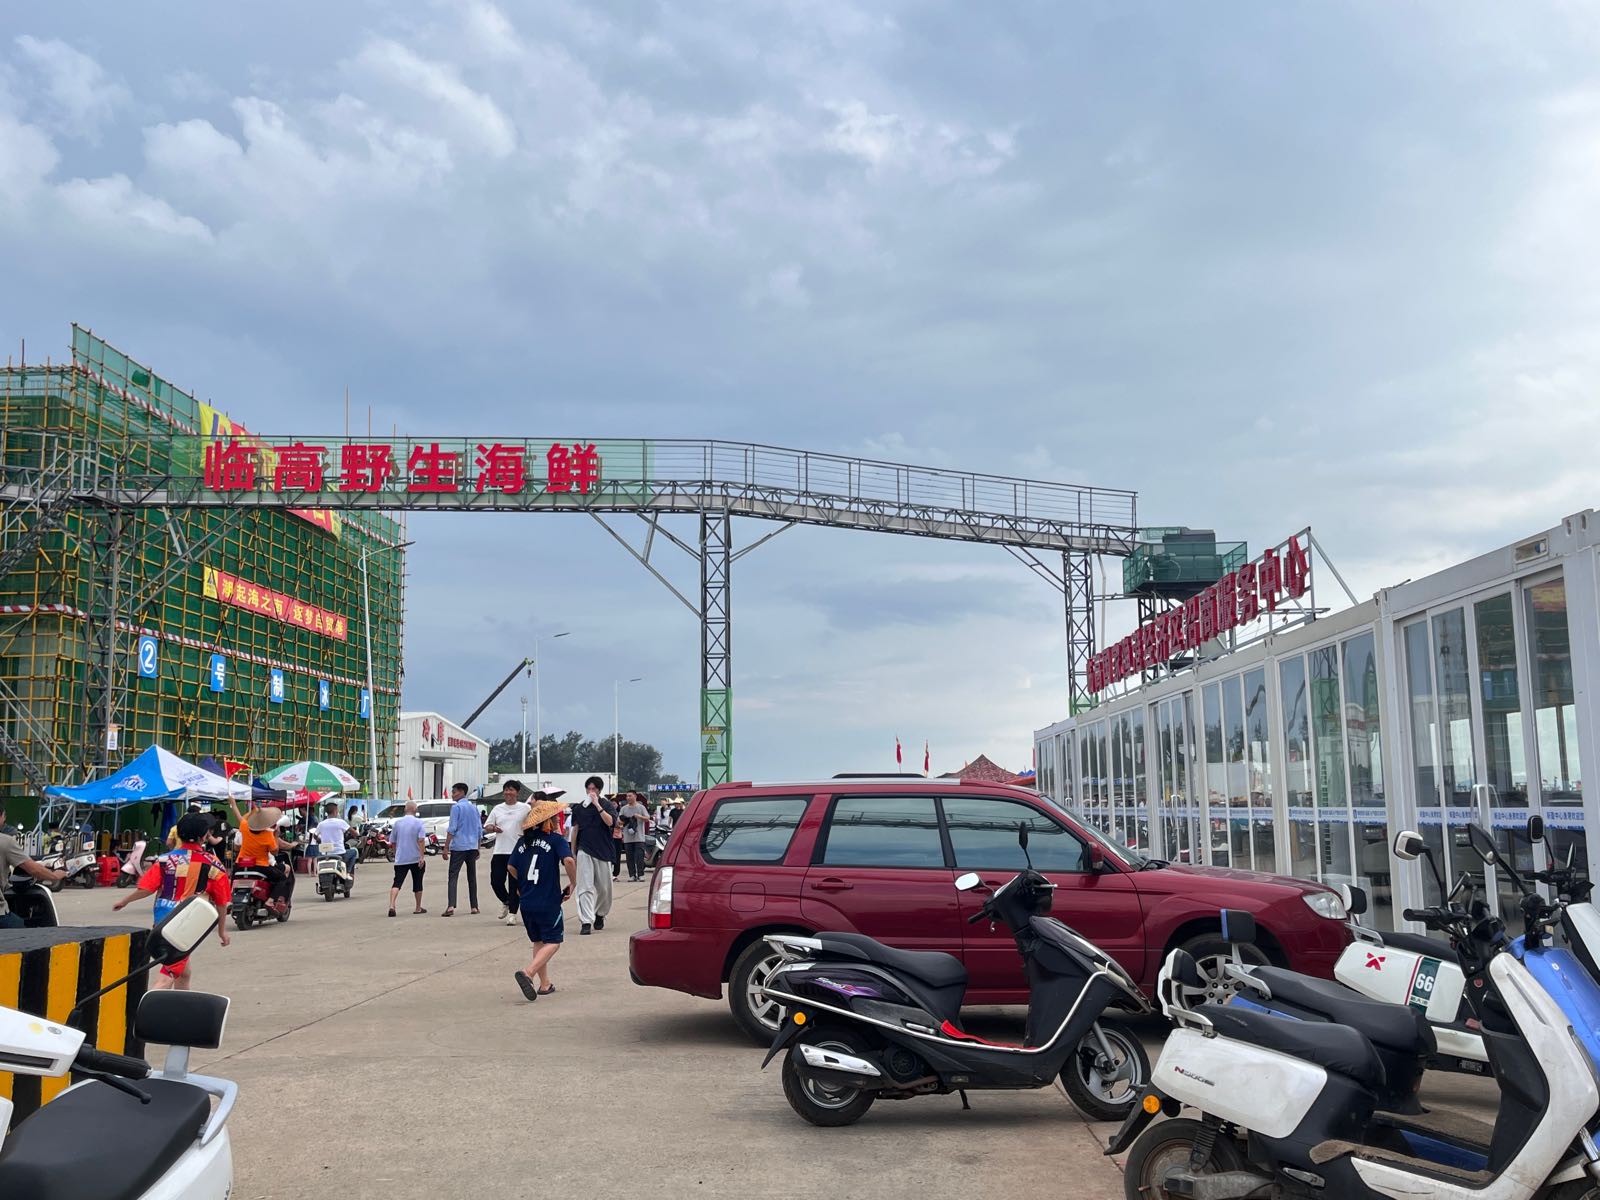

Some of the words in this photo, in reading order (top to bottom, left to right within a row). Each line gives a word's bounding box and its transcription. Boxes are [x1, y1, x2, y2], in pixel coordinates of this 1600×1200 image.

[204, 440, 599, 494] 临高野生海鲜
[527, 854, 539, 885] 4
[1415, 973, 1435, 993] 66
